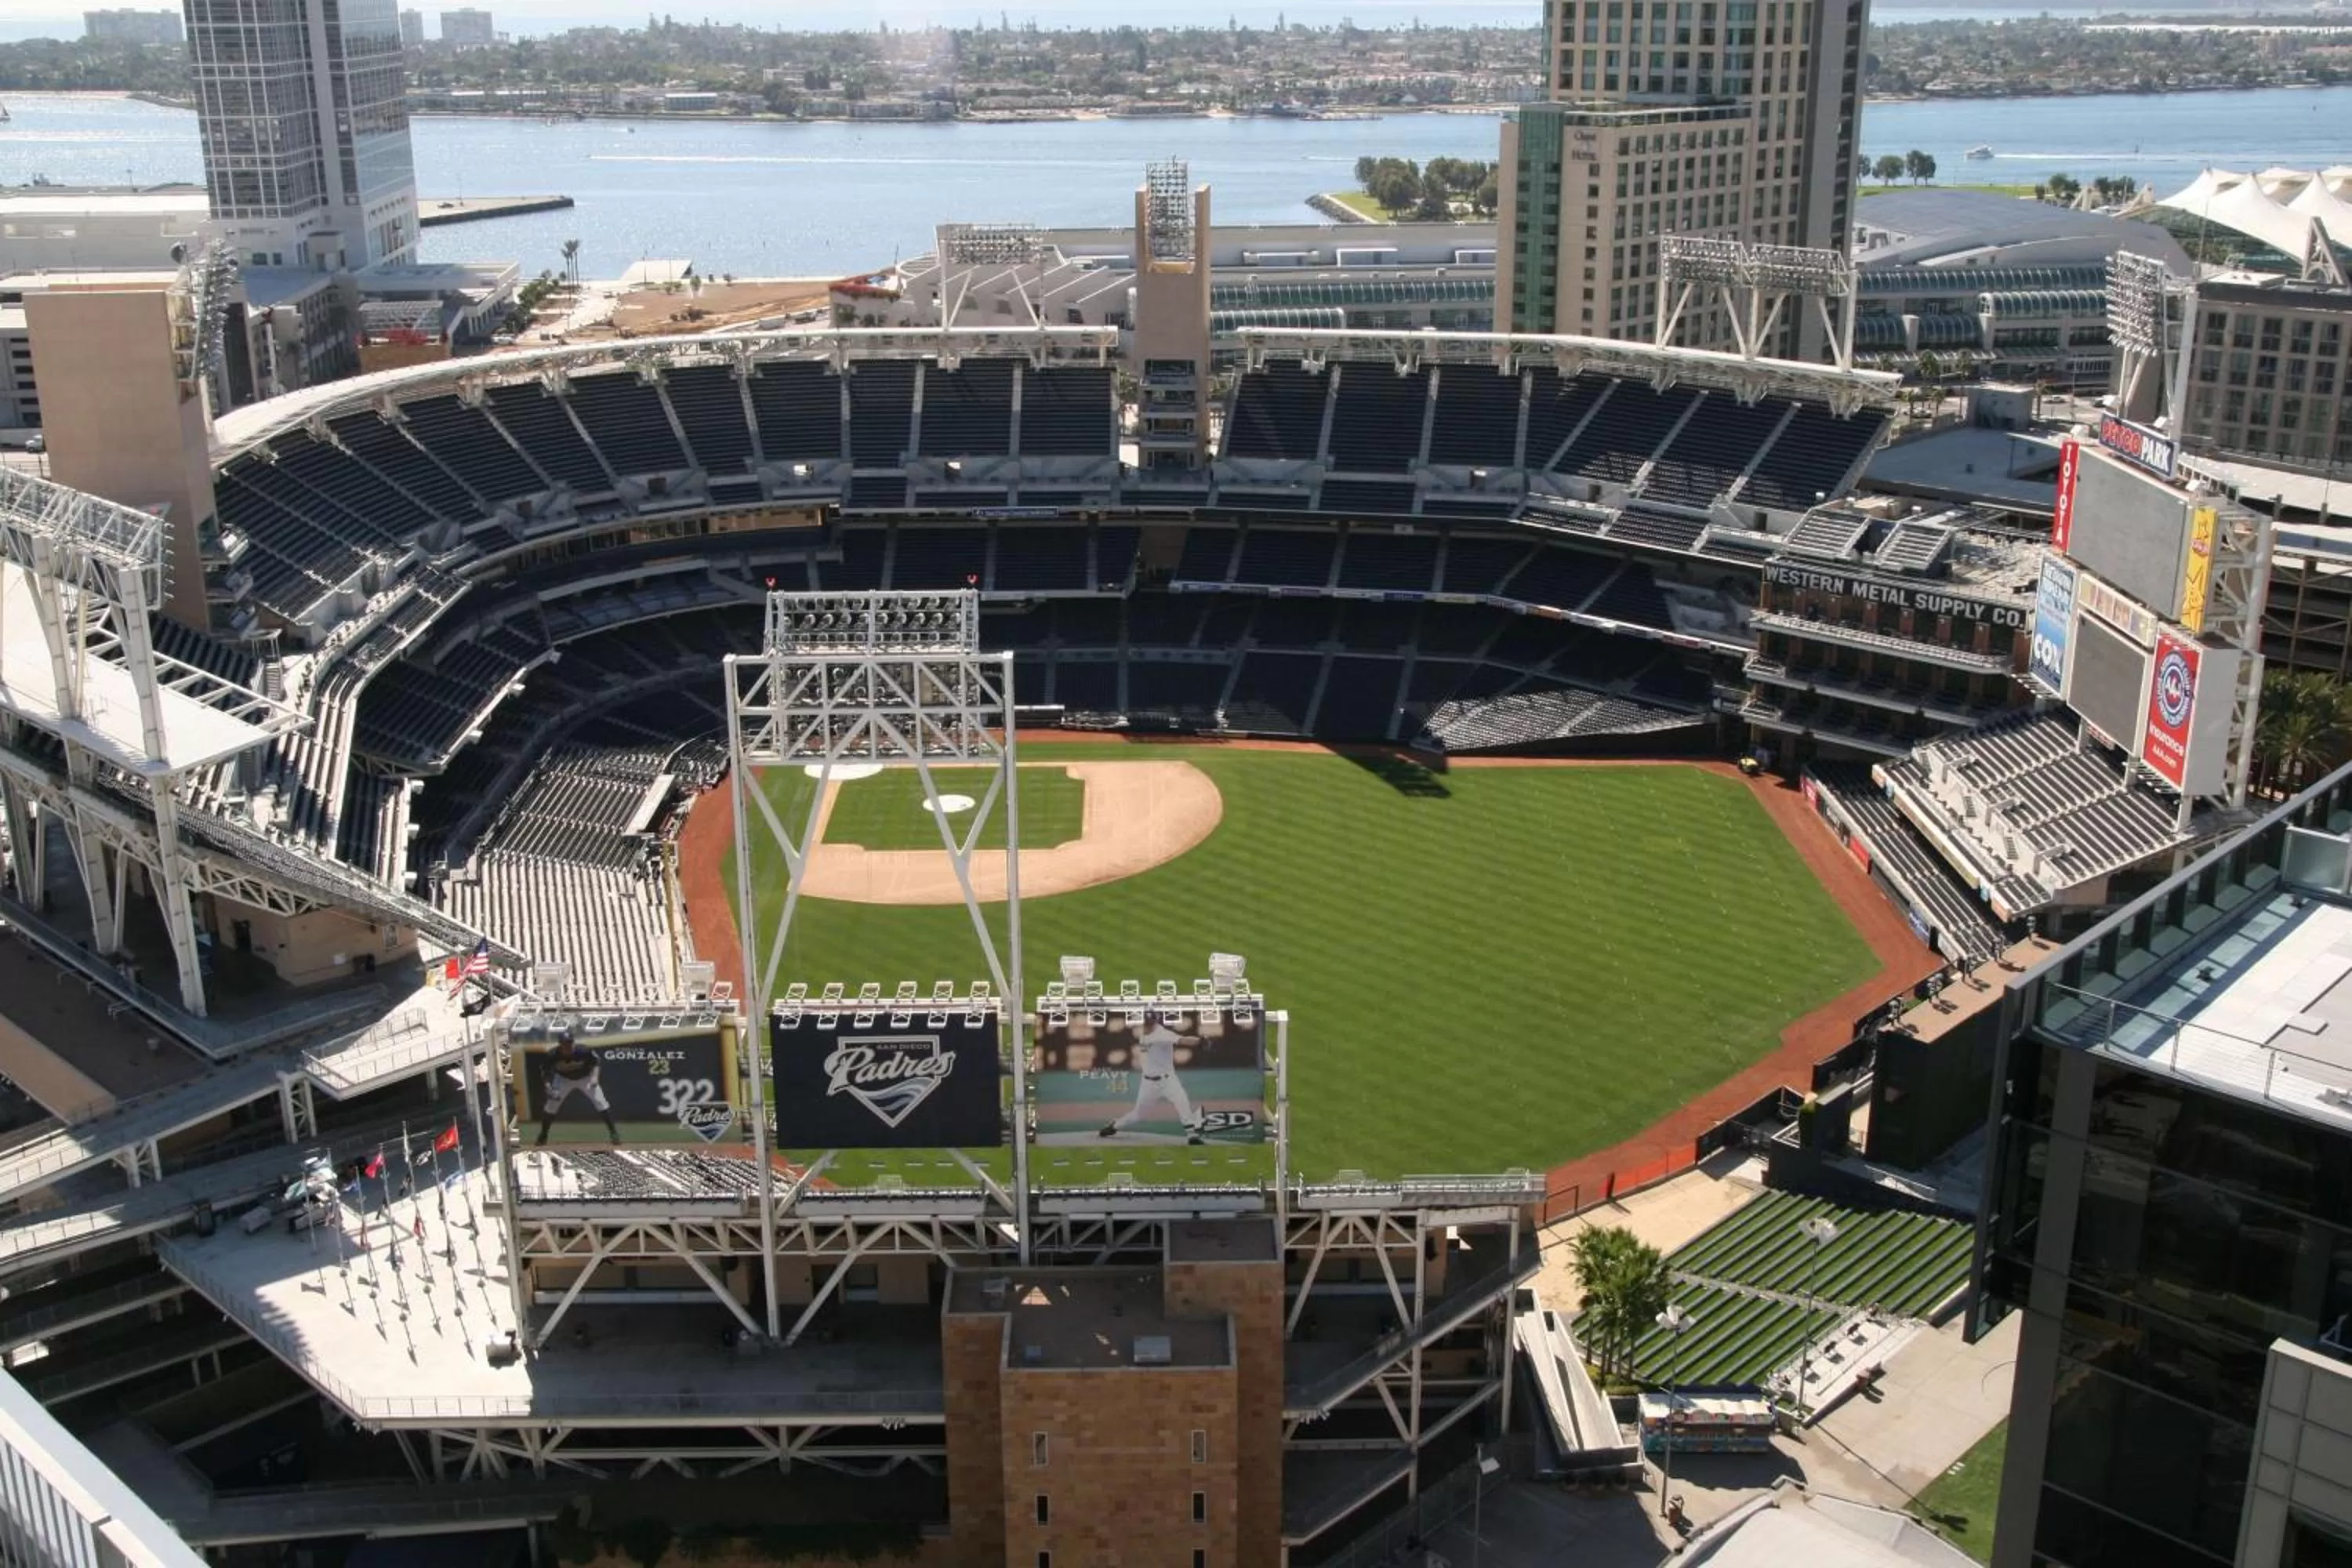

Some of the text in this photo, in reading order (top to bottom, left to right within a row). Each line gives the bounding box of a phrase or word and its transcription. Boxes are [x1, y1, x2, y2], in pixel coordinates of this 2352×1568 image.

[2103, 418, 2171, 472] PETCO PARK
[2056, 444, 2072, 543] TOYOTA
[1766, 565, 1845, 593] WESTERN
[1852, 581, 1910, 607] METAL
[1915, 592, 1985, 620] SUPPLY
[1992, 608, 2025, 627] CO.
[604, 1050, 686, 1060] GONZALEZ
[648, 1058, 671, 1075] 23
[824, 1046, 956, 1096] Padres
[1080, 1070, 1129, 1080] PEAVY
[657, 1079, 715, 1114] 322
